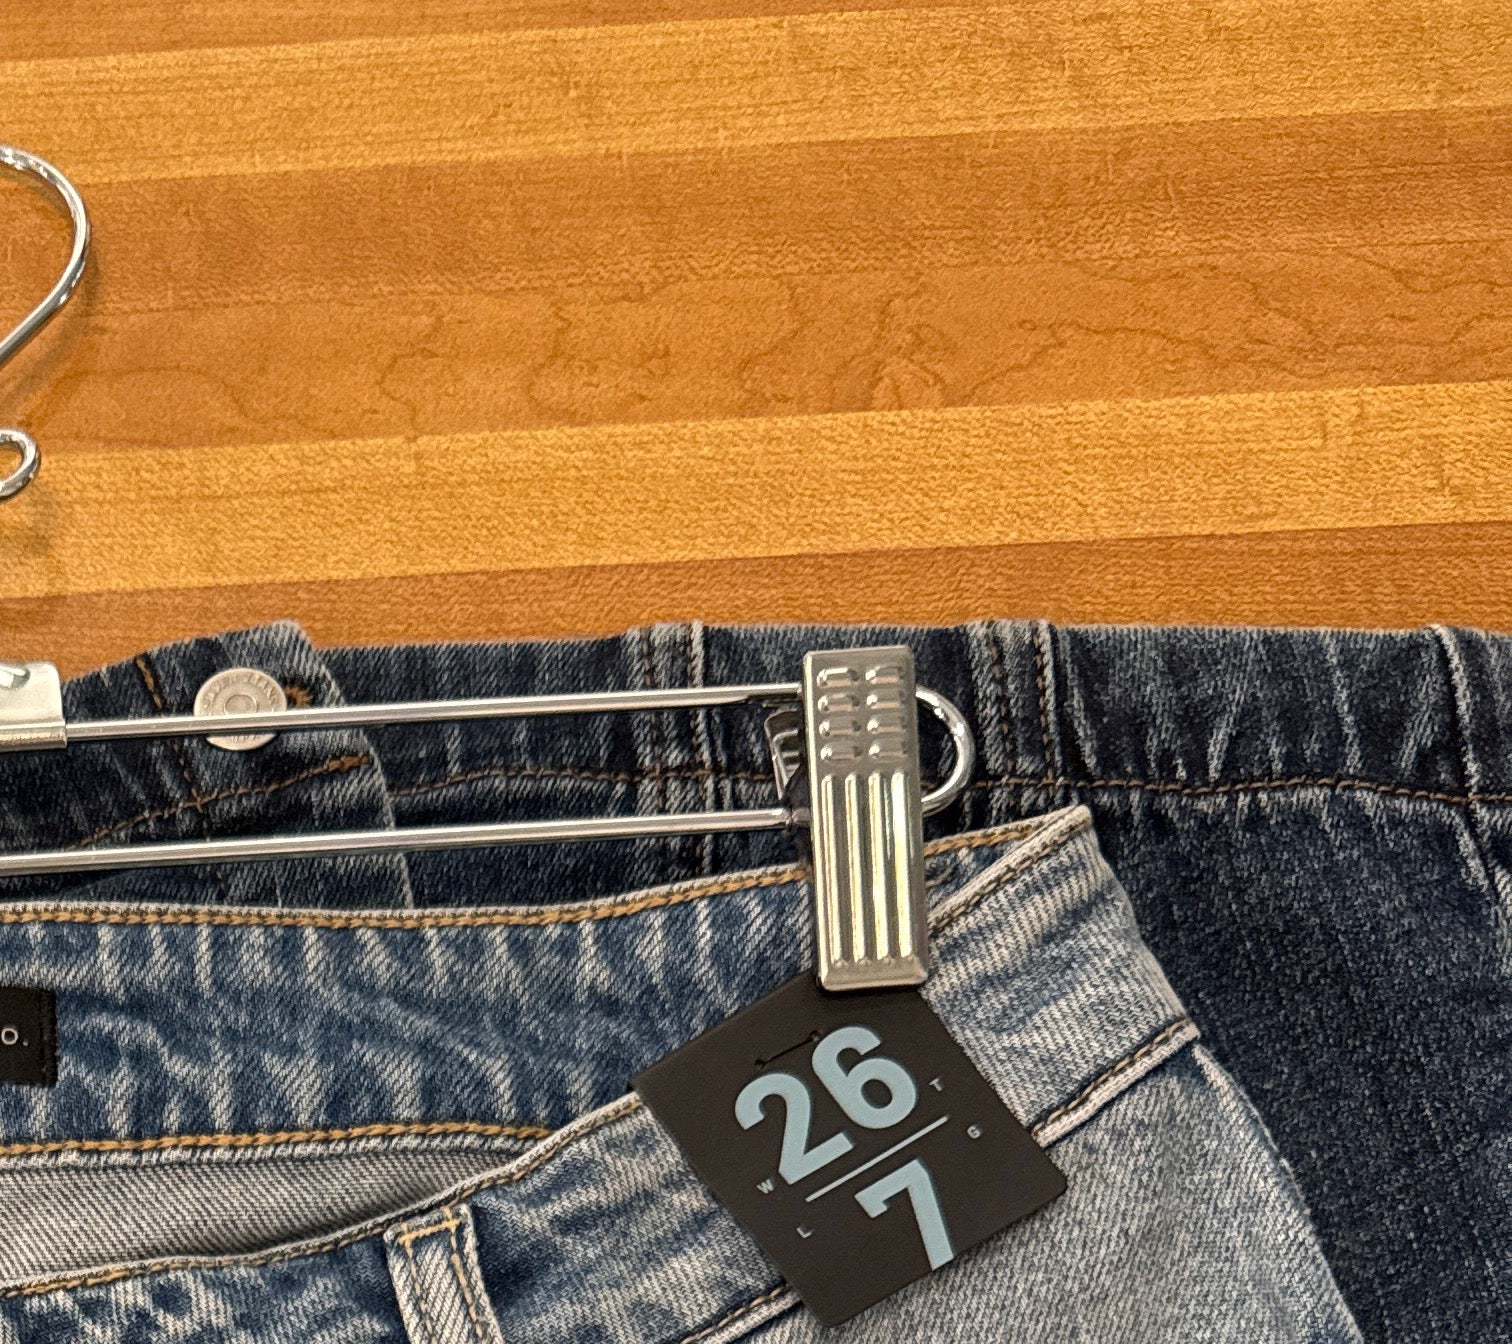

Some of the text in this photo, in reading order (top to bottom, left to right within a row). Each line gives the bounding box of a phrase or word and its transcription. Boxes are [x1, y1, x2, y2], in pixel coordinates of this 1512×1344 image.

[734, 1026, 917, 1186] 26
[756, 1179, 774, 1194] W
[796, 1226, 813, 1239] L
[854, 1158, 955, 1271] 7
